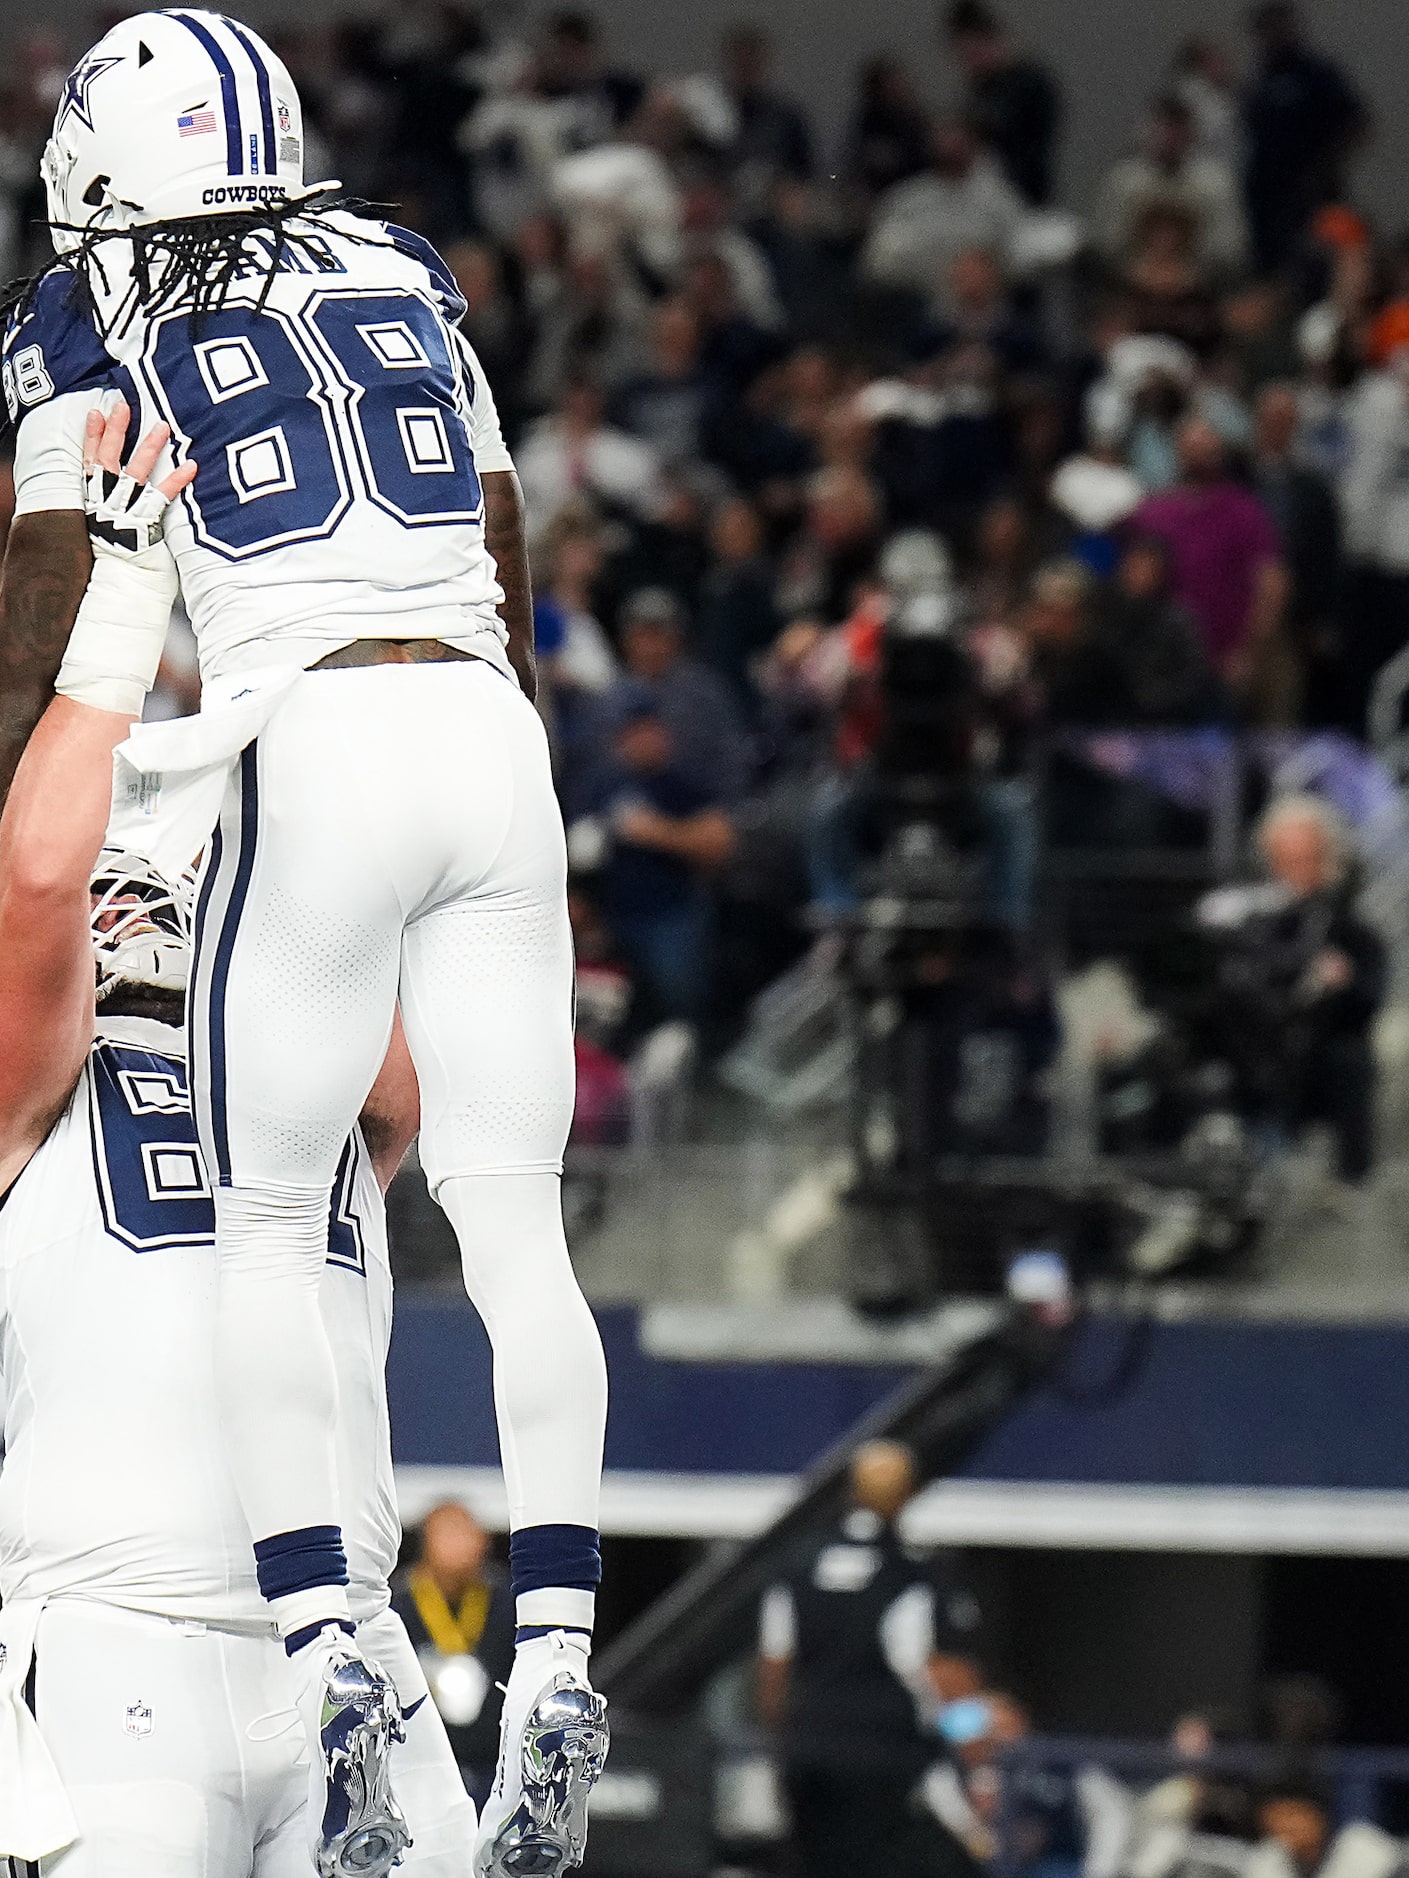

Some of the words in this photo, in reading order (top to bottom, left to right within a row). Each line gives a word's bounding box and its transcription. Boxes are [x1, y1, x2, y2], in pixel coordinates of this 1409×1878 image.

[202, 186, 286, 204] COWBOYS
[220, 233, 349, 280] AMB
[2, 343, 56, 424] 88
[140, 288, 485, 562] 88
